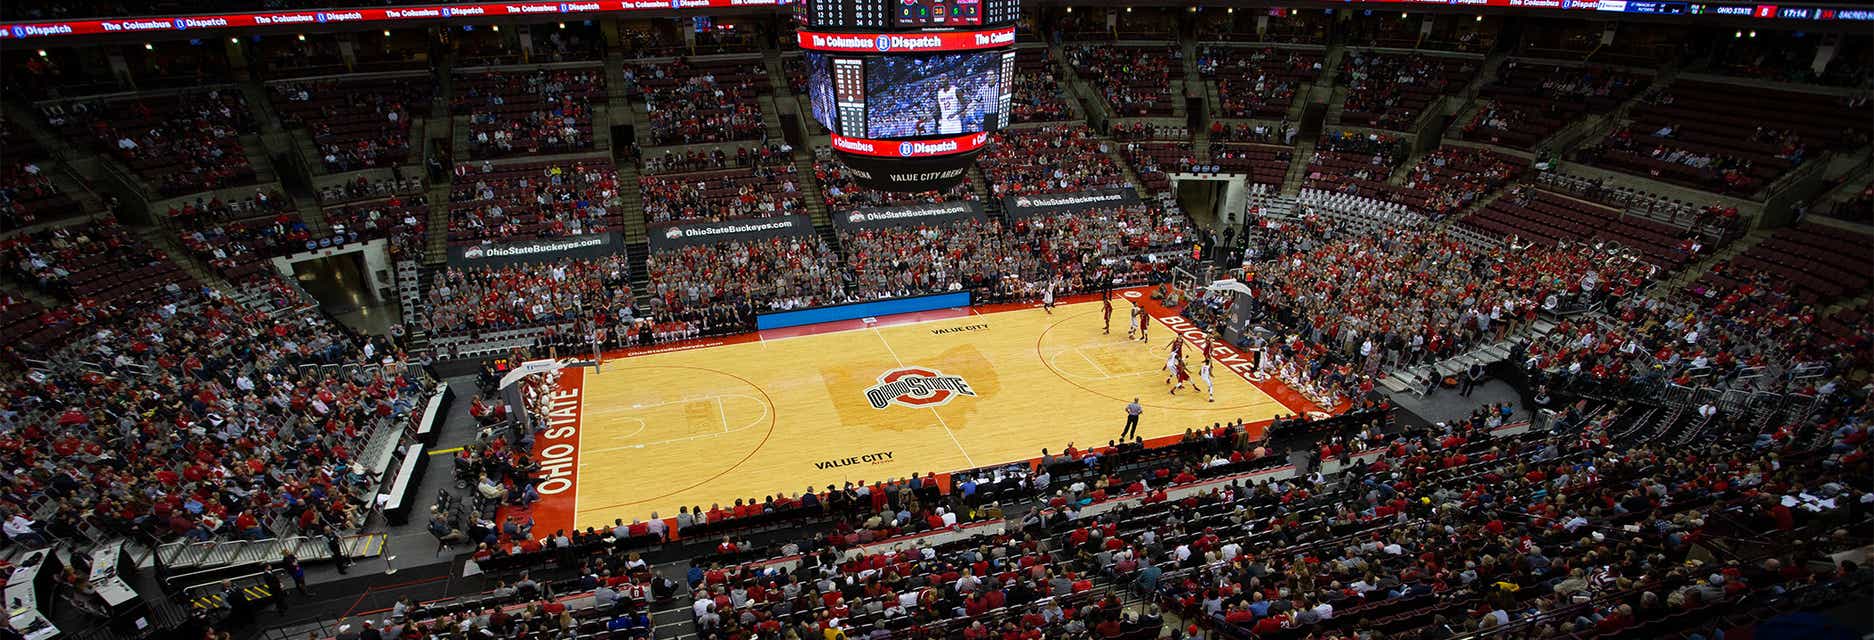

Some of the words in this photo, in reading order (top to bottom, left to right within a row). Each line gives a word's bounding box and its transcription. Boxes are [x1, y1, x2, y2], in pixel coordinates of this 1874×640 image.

[506, 5, 521, 13] The
[522, 4, 557, 12] Columbus
[568, 3, 600, 11] Dispatch
[621, 1, 636, 9] The
[637, 0, 669, 8] Columbus
[1717, 7, 1733, 15] OHIO
[254, 15, 271, 24] The
[272, 14, 314, 23] Columbus
[326, 12, 363, 21] Dispatch
[385, 10, 401, 18] The
[401, 8, 439, 17] Columbus
[450, 7, 485, 16] Dispatch
[1783, 9, 1807, 18] 17:14
[25, 24, 73, 36] Dispatch
[101, 22, 120, 32] The
[122, 21, 172, 31] Columbus
[186, 17, 228, 27] Dispatch
[812, 35, 825, 47] The
[826, 36, 873, 48] Columbus
[891, 36, 942, 50] Dispatch
[975, 33, 990, 46] The
[837, 138, 874, 153] Columbus
[913, 140, 958, 155] Dispatch
[889, 173, 919, 182] VALUE
[920, 171, 940, 181] CITY
[1032, 194, 1122, 207] OhioStateBuckeyes.com
[866, 205, 965, 221] OhioStateBuckeyes.com
[685, 220, 793, 237] OhioStateBuckeyes.com
[485, 237, 602, 257] OhioStateBuckeyes.com
[931, 327, 965, 335] VALUE
[543, 387, 579, 440] STATE
[814, 456, 861, 470] VALUE
[861, 451, 893, 463] CITY
[536, 443, 575, 495] OHIO
